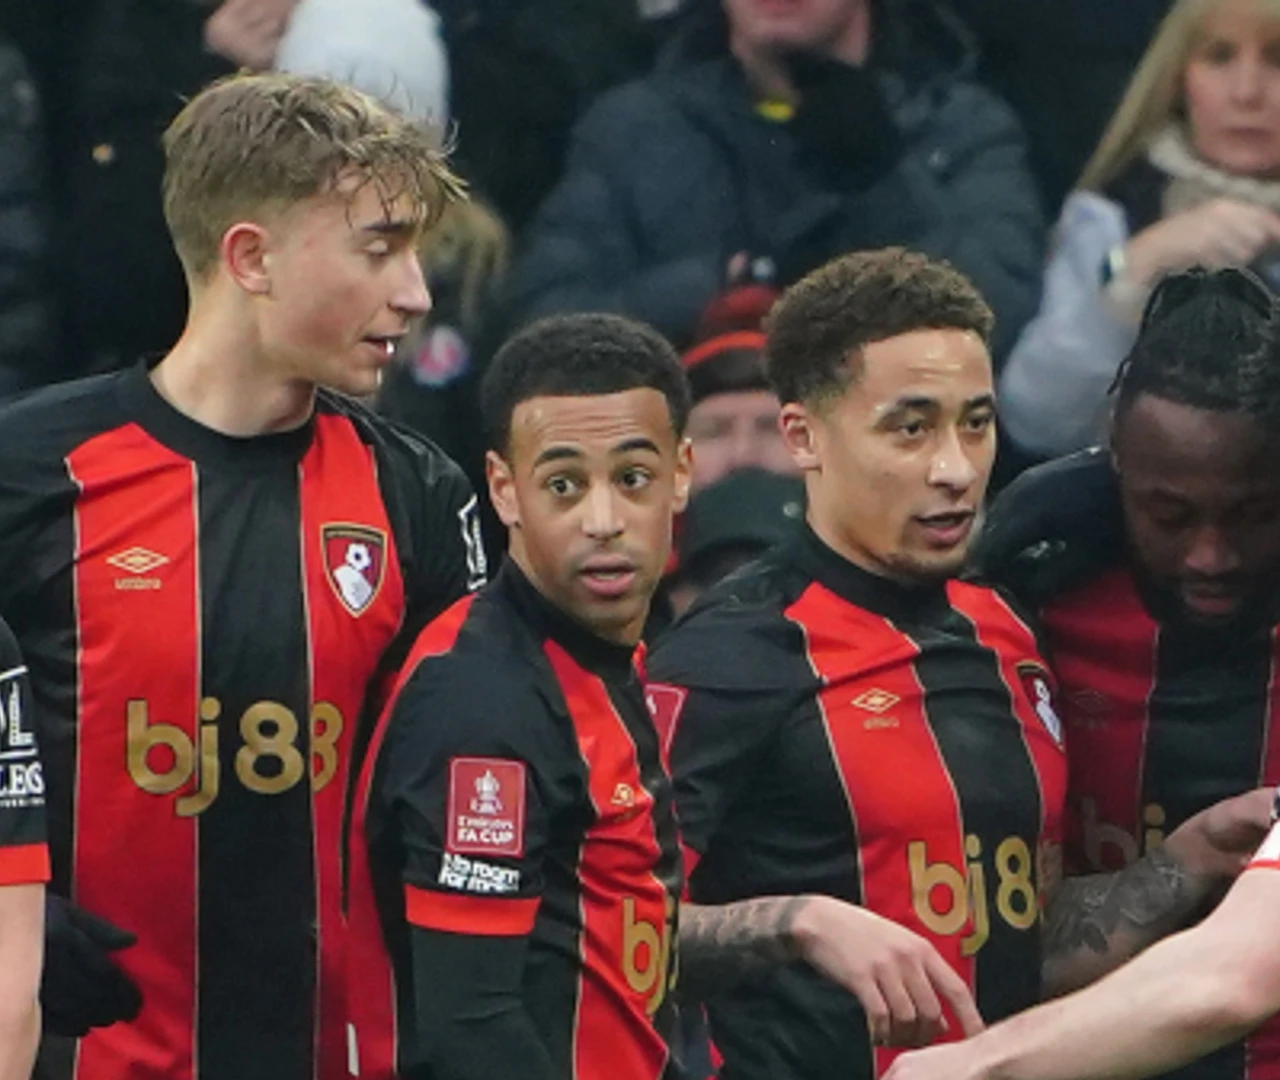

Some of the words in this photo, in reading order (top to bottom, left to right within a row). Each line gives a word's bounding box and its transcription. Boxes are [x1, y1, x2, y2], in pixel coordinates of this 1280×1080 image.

[127, 696, 344, 816] bj88
[457, 828, 478, 843] FA
[480, 829, 515, 845] CUP
